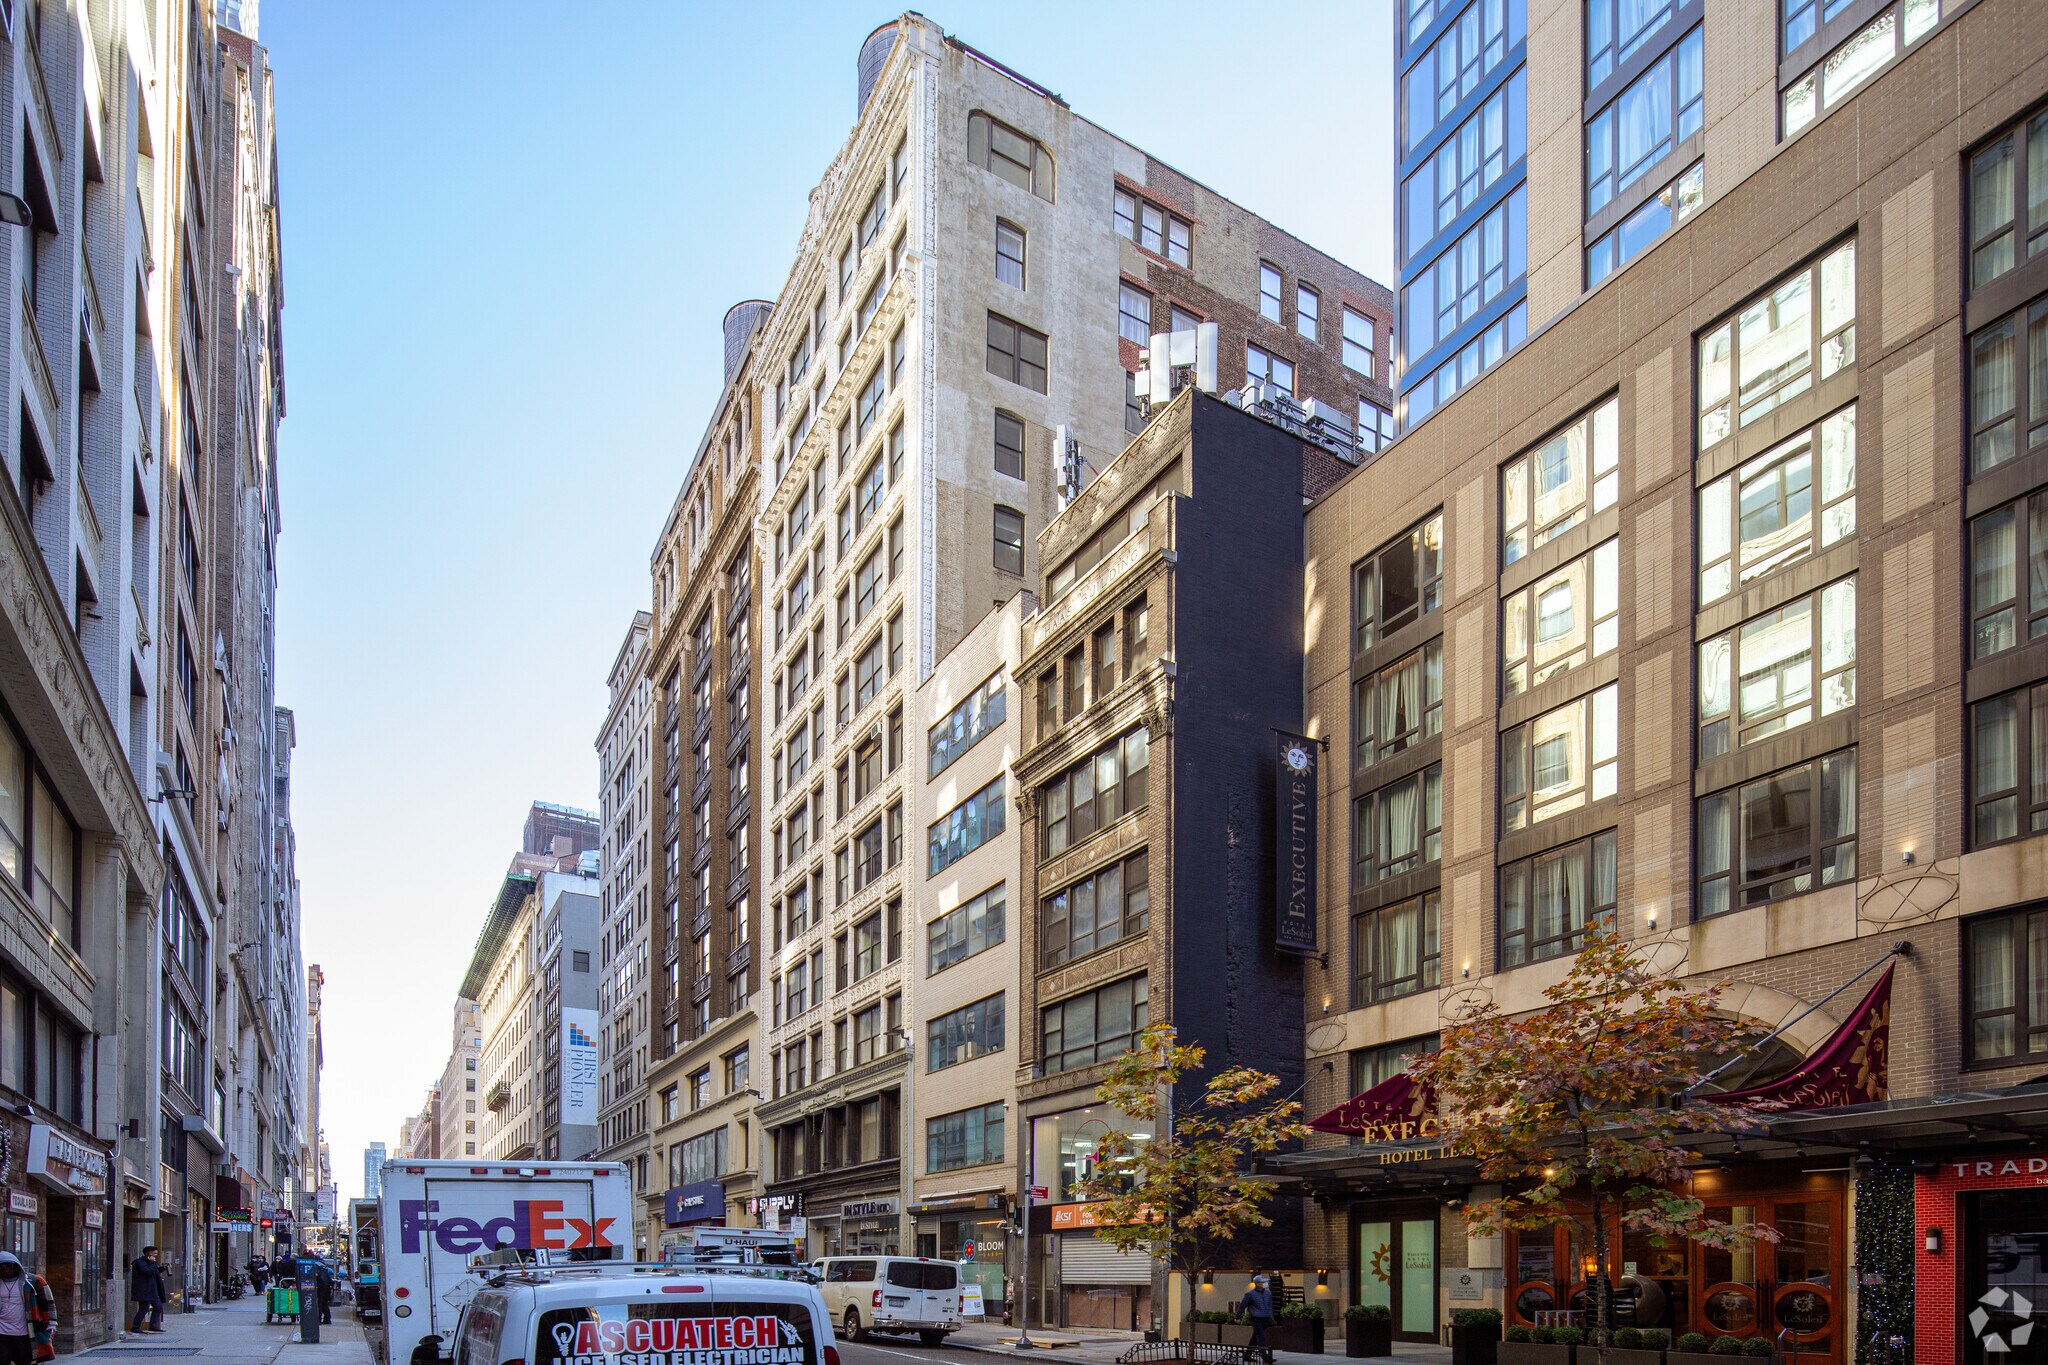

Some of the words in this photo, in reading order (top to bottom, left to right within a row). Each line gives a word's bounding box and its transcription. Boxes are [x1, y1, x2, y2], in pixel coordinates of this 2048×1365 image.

[1289, 782, 1306, 918] EXECUTIVE
[570, 1049, 584, 1108] PIONEER
[584, 1050, 597, 1089] FIRST
[1380, 1149, 1432, 1165] HOTEL
[1440, 1147, 1460, 1159] LE
[399, 1200, 617, 1254] FedEx
[1079, 1218, 1095, 1226] LEASE
[978, 1241, 1004, 1251] BLOOM
[1405, 1261, 1432, 1269] LeSoleil
[1784, 1314, 1823, 1323] LeSoleil
[574, 1316, 779, 1356] ASCUATECH
[671, 1346, 804, 1365] ELECTRICIAN
